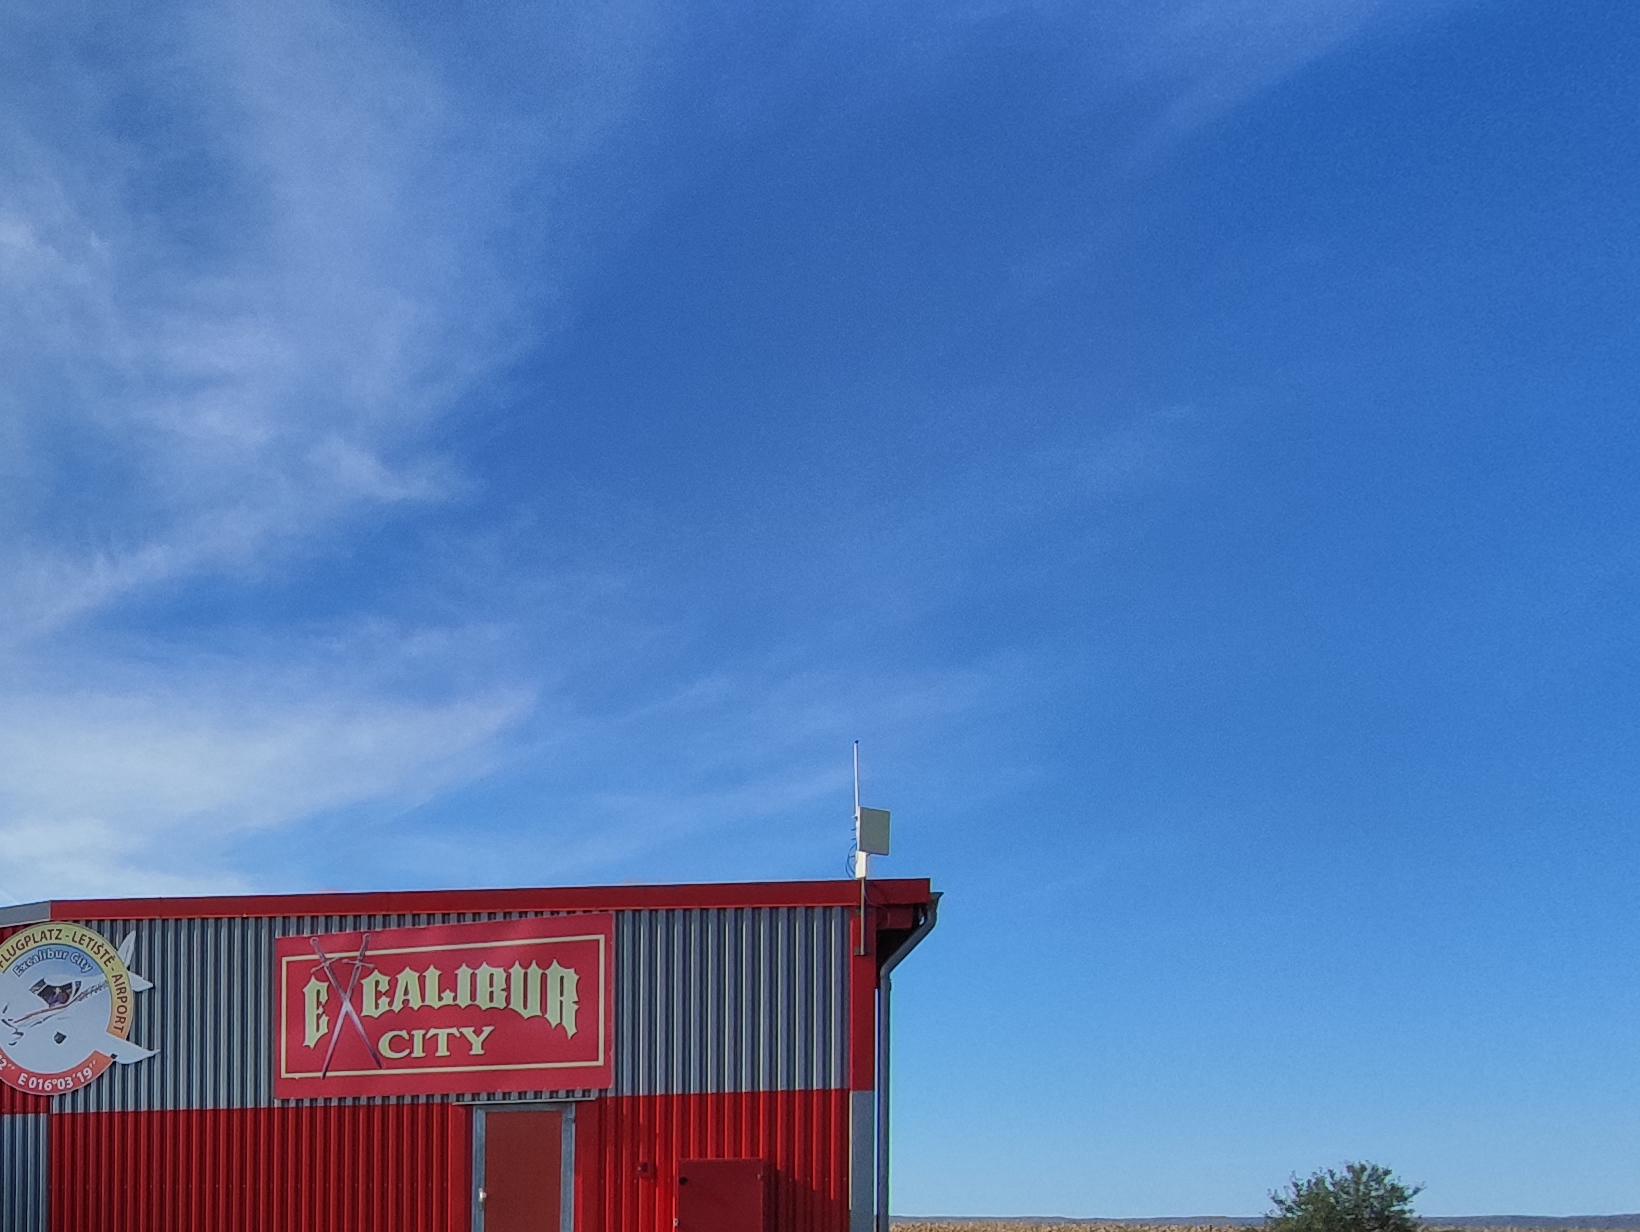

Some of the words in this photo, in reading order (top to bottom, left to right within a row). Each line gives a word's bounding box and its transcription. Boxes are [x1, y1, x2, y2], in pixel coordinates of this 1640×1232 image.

[12, 948, 69, 977] Excalibur
[70, 952, 93, 973] City
[111, 973, 128, 1034] AIRPORT
[302, 933, 580, 1080] EXCALIBUR
[378, 1025, 495, 1059] CITY
[17, 1072, 28, 1086] E
